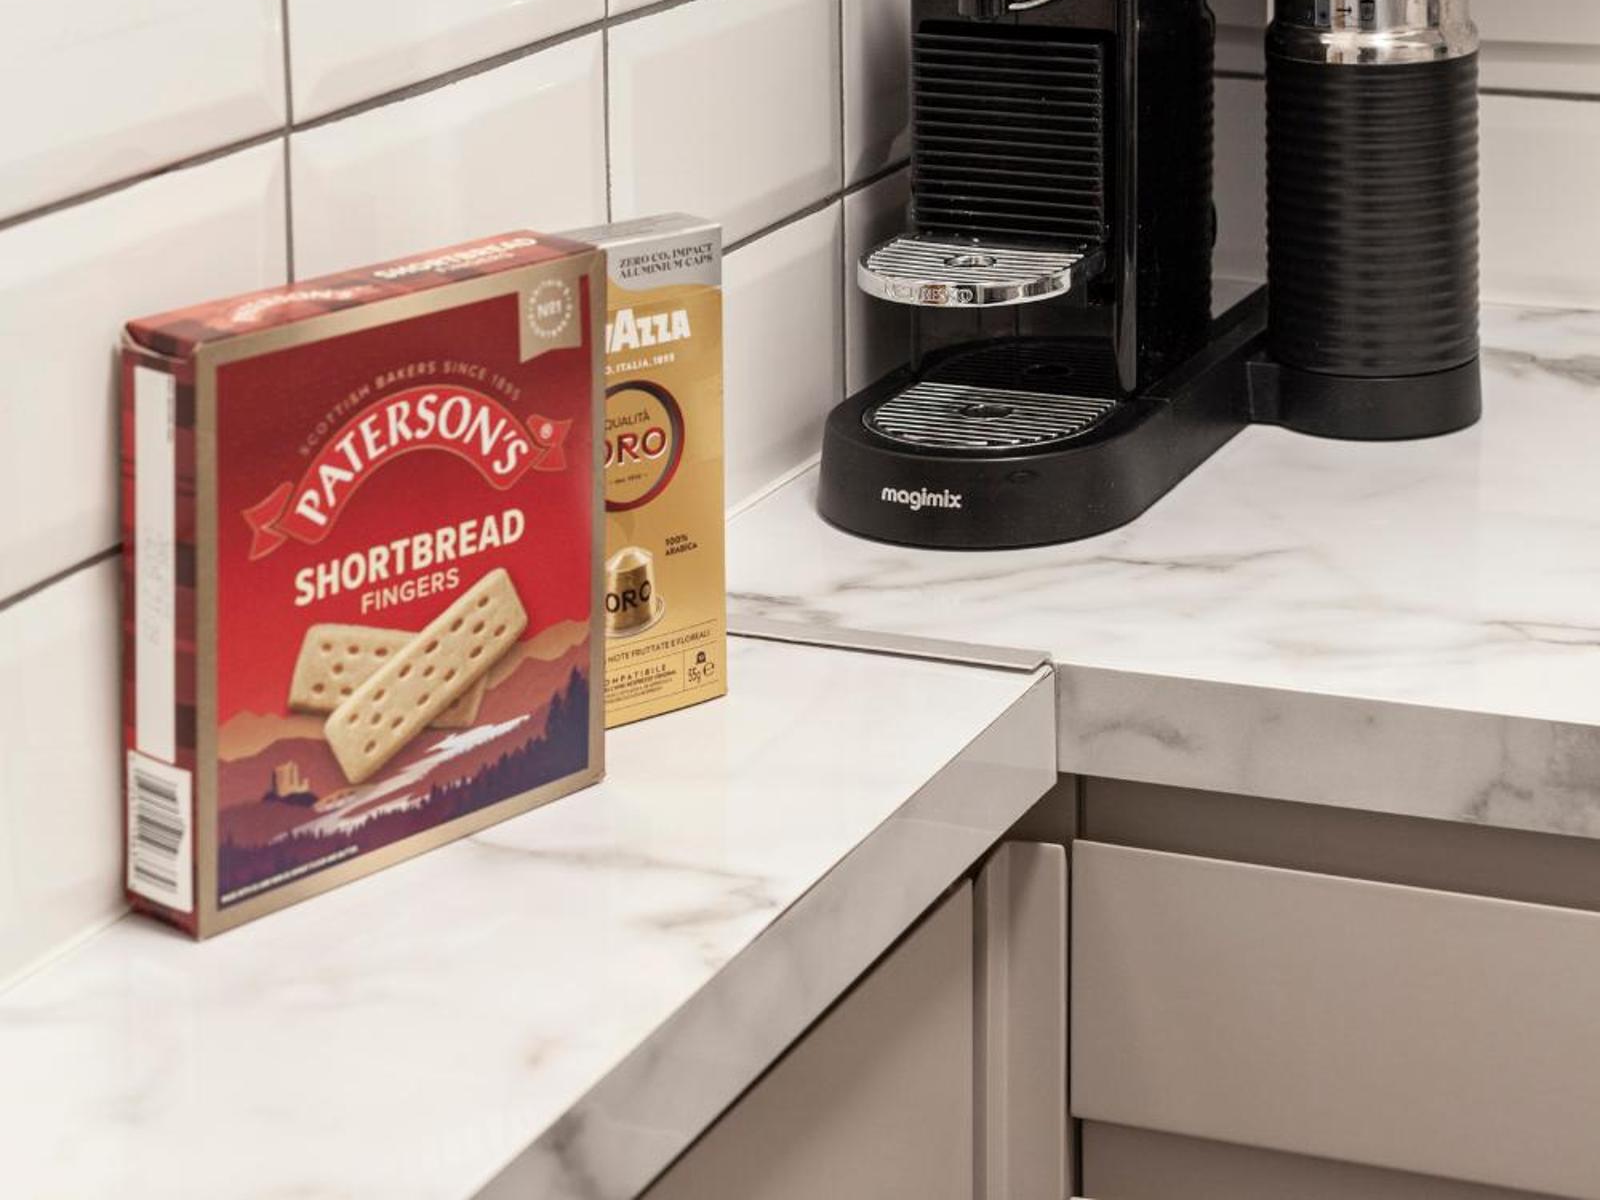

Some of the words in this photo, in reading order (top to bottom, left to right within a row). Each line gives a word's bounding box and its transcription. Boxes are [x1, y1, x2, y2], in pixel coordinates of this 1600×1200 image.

[619, 254, 650, 269] ZERO
[673, 243, 713, 258] IMPACT
[620, 258, 684, 279] ALUMINIUM
[685, 253, 713, 268] CAPS
[298, 384, 371, 457] SCOTTISH
[375, 360, 437, 390] BAKERS
[443, 360, 487, 381] SINCE
[295, 393, 529, 526] PATERSON'S
[881, 486, 963, 511] magimix
[665, 533, 689, 546] 100%
[665, 541, 698, 557] ARABICA
[294, 507, 526, 607] SHORTBREAD
[361, 567, 460, 615] FINGERS
[605, 580, 652, 613] ORO
[605, 663, 667, 686] OMPATIBILE
